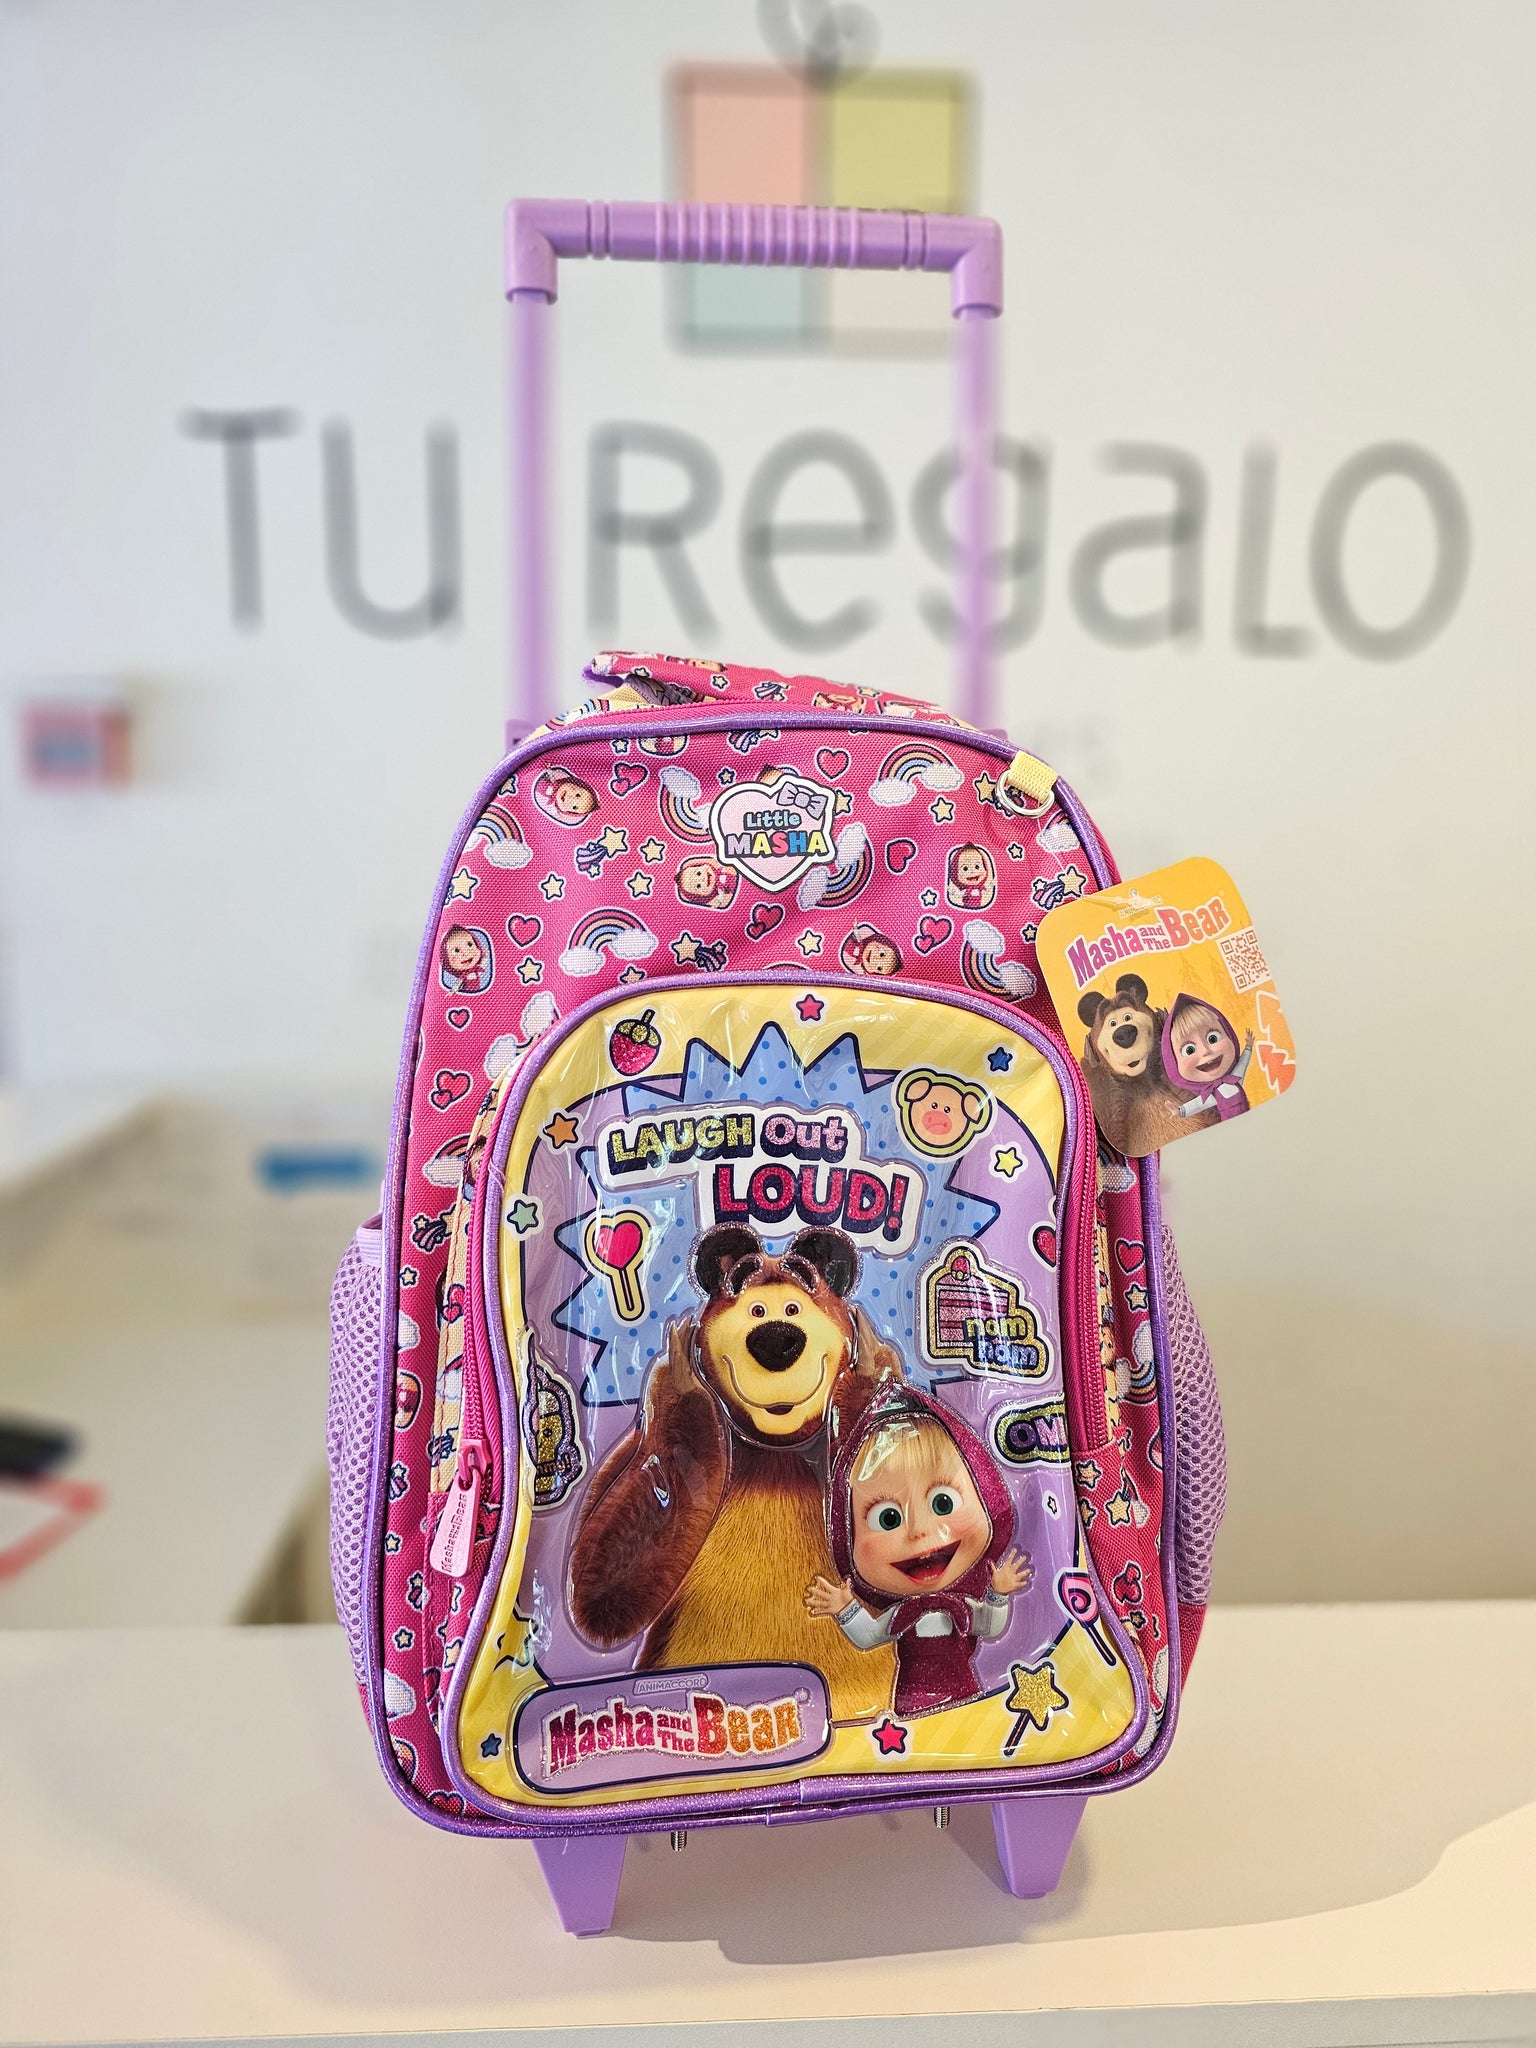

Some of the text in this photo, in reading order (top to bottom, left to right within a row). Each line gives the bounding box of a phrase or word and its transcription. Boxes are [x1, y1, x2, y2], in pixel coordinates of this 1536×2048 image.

[743, 809, 802, 830] Little
[725, 830, 830, 858] MASHA
[1138, 925, 1166, 936] and
[1143, 938, 1171, 950] The
[1067, 925, 1144, 988] Masha
[608, 1114, 754, 1174] LAUGH
[712, 1163, 910, 1242] LOUD!
[964, 1315, 1028, 1341] nom
[636, 1676, 707, 1693] ANIMACCORD
[656, 1712, 692, 1734] and
[549, 1702, 655, 1774] Masha
[657, 1731, 695, 1751] The
